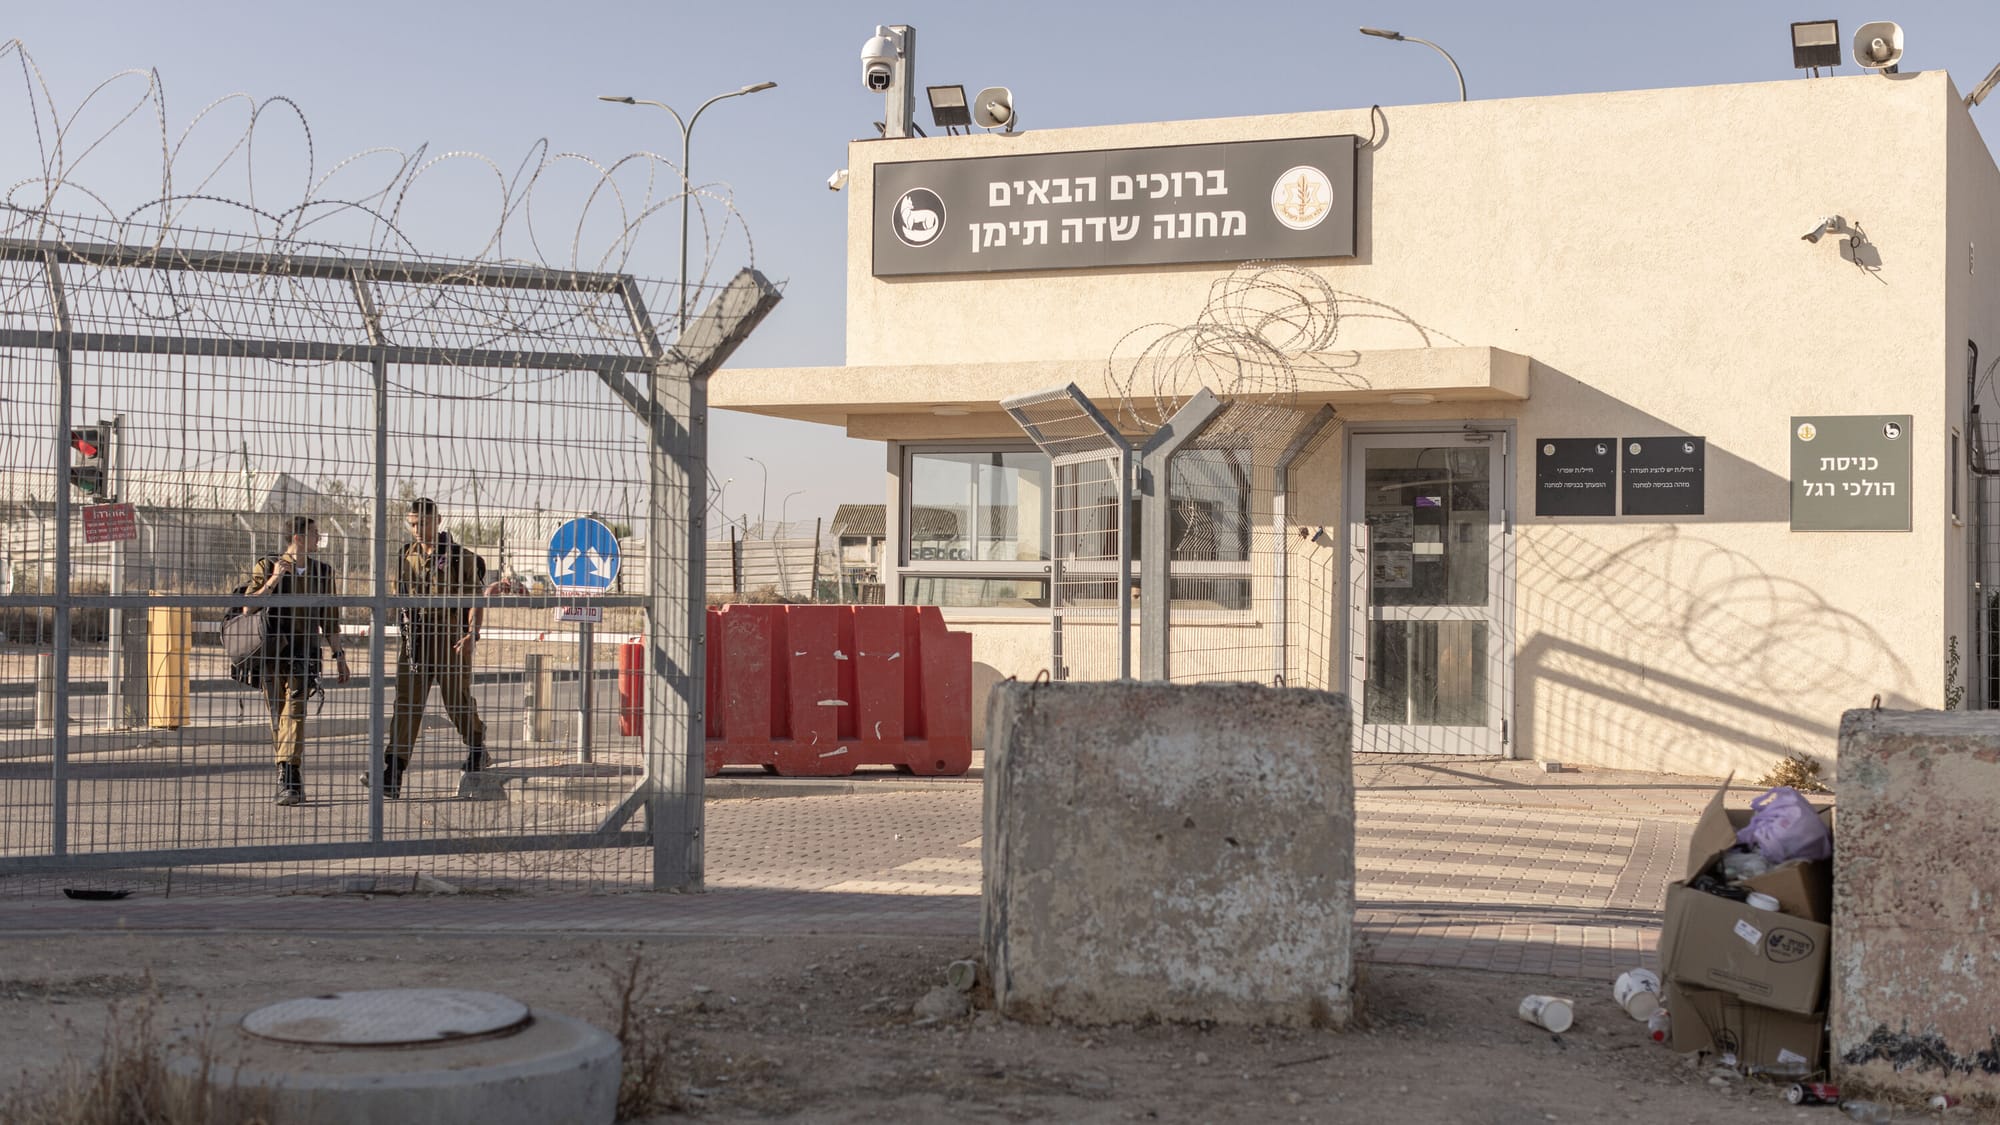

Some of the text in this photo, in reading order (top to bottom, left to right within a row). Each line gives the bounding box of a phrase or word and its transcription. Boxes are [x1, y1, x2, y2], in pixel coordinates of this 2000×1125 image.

[989, 168, 1228, 207] ברוכים הבאים
[969, 218, 1048, 253] תימן
[1062, 214, 1141, 244] שדה
[1153, 209, 1247, 240] מחנה
[1820, 457, 1879, 471] כניסת
[1803, 479, 1895, 496] הולכי רגל
